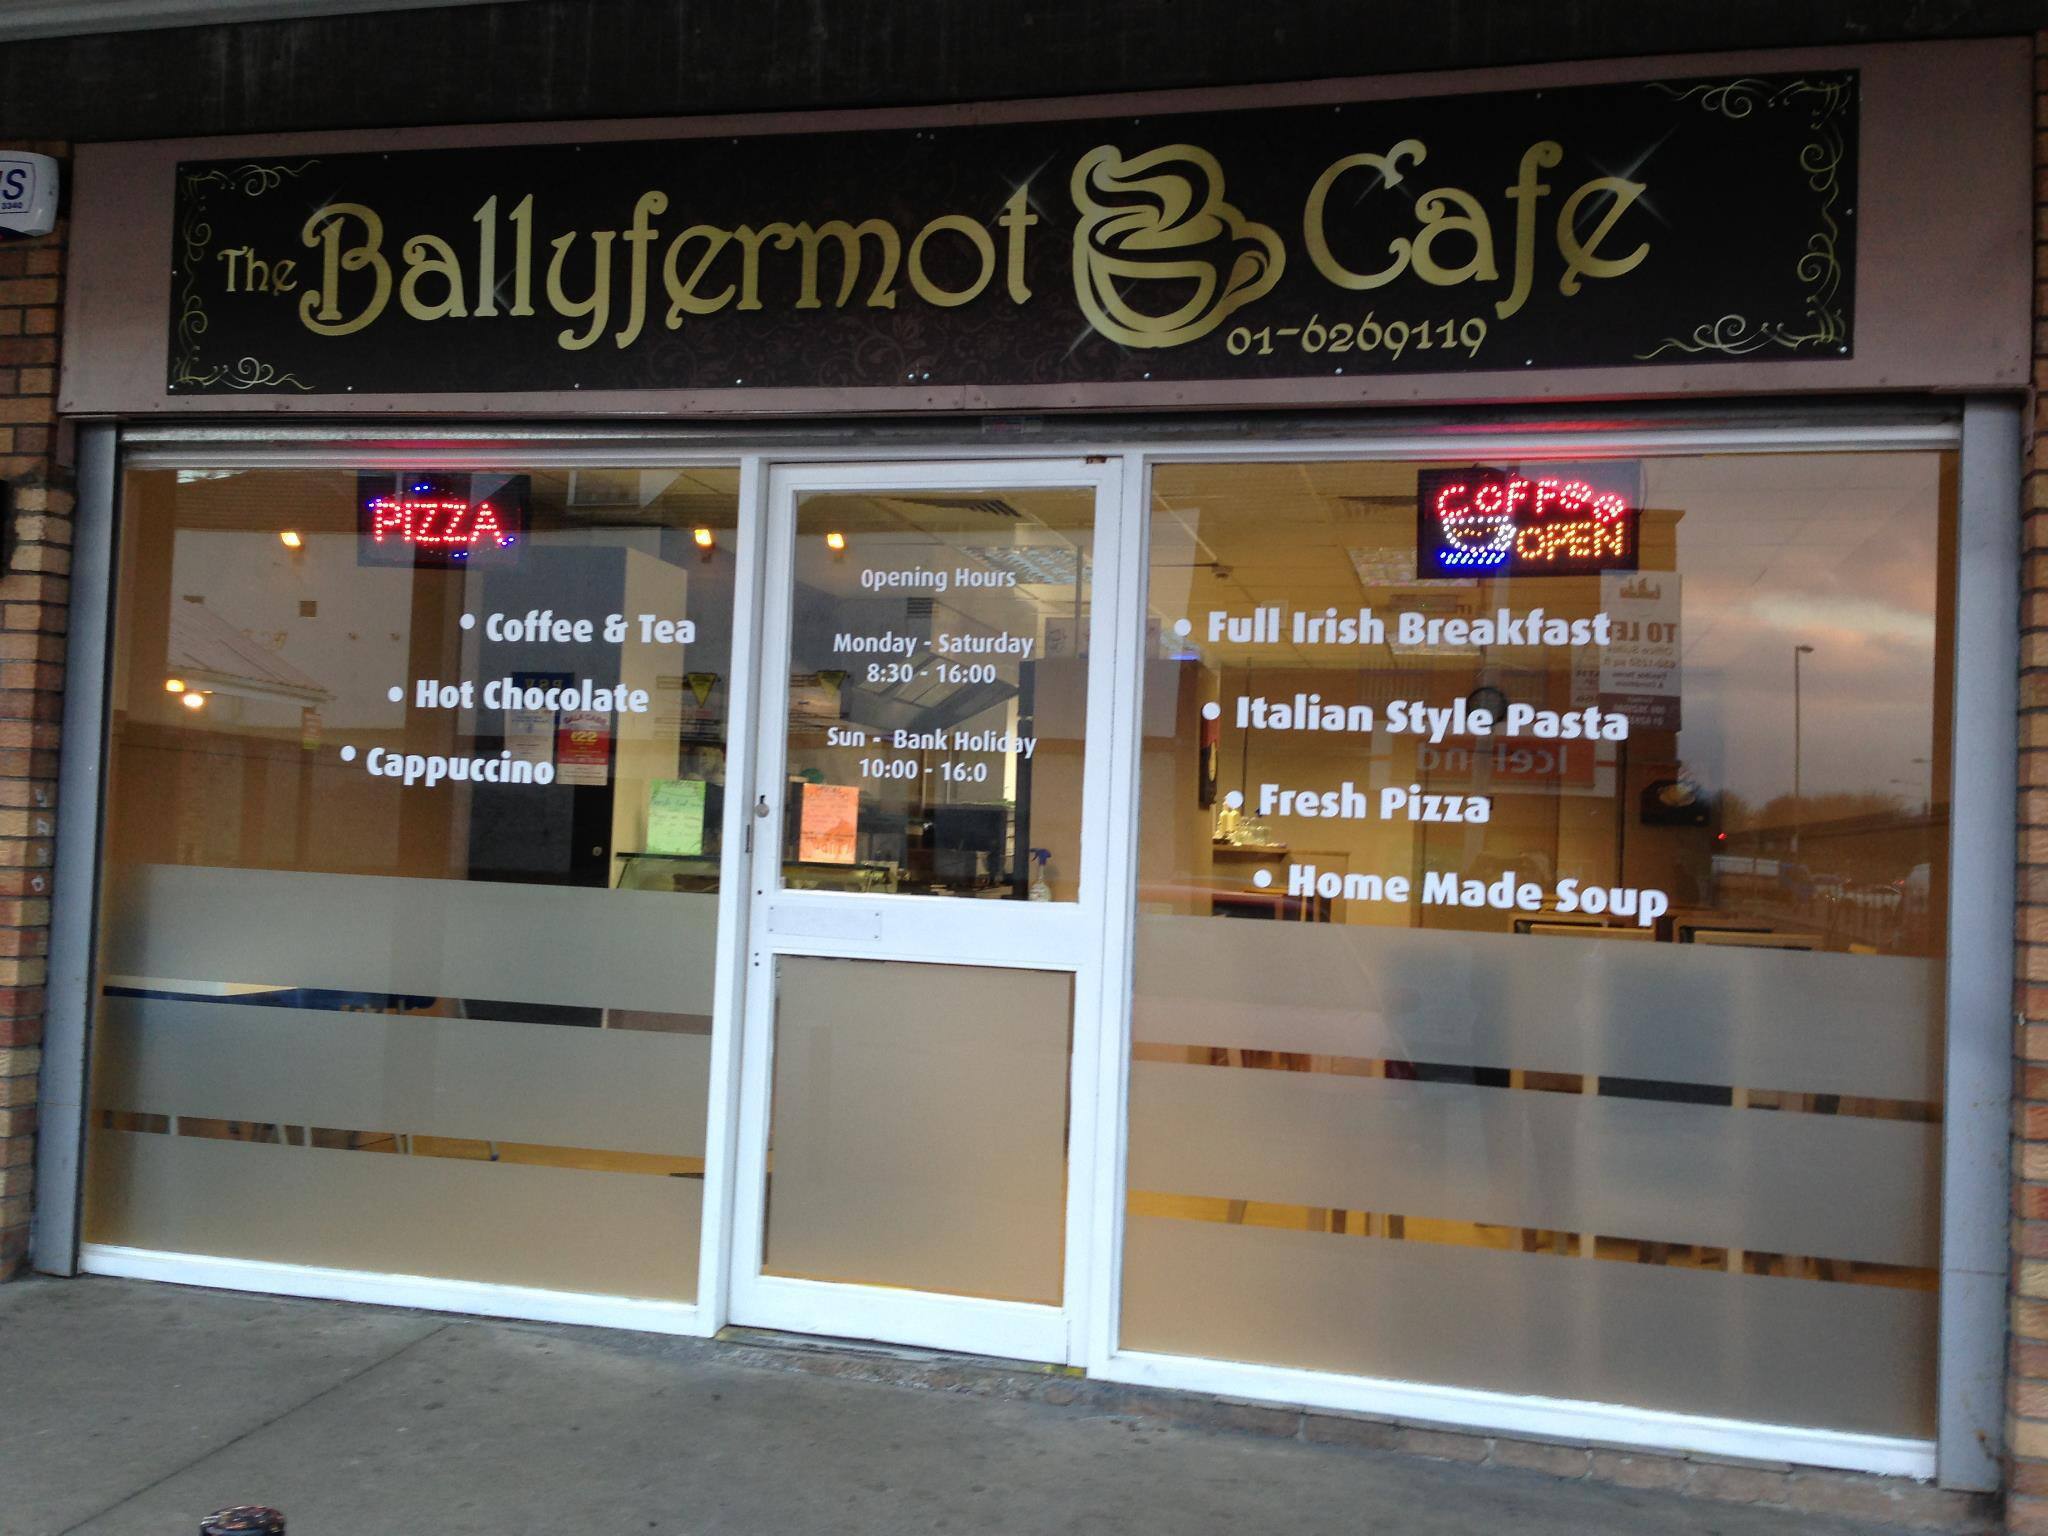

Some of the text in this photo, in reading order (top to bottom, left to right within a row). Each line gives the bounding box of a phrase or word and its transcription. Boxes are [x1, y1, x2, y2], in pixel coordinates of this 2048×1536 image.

[216, 138, 1650, 352] The Ballyfermot Cafe
[1226, 311, 1488, 360] 01-6269119
[372, 498, 505, 544] PIZZA
[1516, 519, 1624, 561] OPEN
[860, 565, 1017, 593] Opening Hours
[486, 609, 695, 644] Coffee & Tea
[833, 630, 918, 658] Monday
[937, 631, 1035, 659] Saturday
[1208, 607, 1611, 646] Full Irish Breakfast
[866, 662, 914, 684] 8:30
[935, 663, 997, 684] 16:00
[416, 677, 650, 714] Hot Chocolate
[1236, 693, 1374, 732] Italian
[1385, 697, 1493, 744] Style
[1506, 703, 1629, 741] Pasta
[826, 726, 866, 748] Sun
[893, 728, 948, 751] Bank
[954, 730, 1037, 759] Holiday
[366, 747, 554, 787] Cappuccino
[858, 757, 919, 780] 10:00
[940, 761, 988, 783] 16:0
[1259, 781, 1490, 824] Fresh Pizza
[1288, 863, 1668, 927] Home Made Soup
